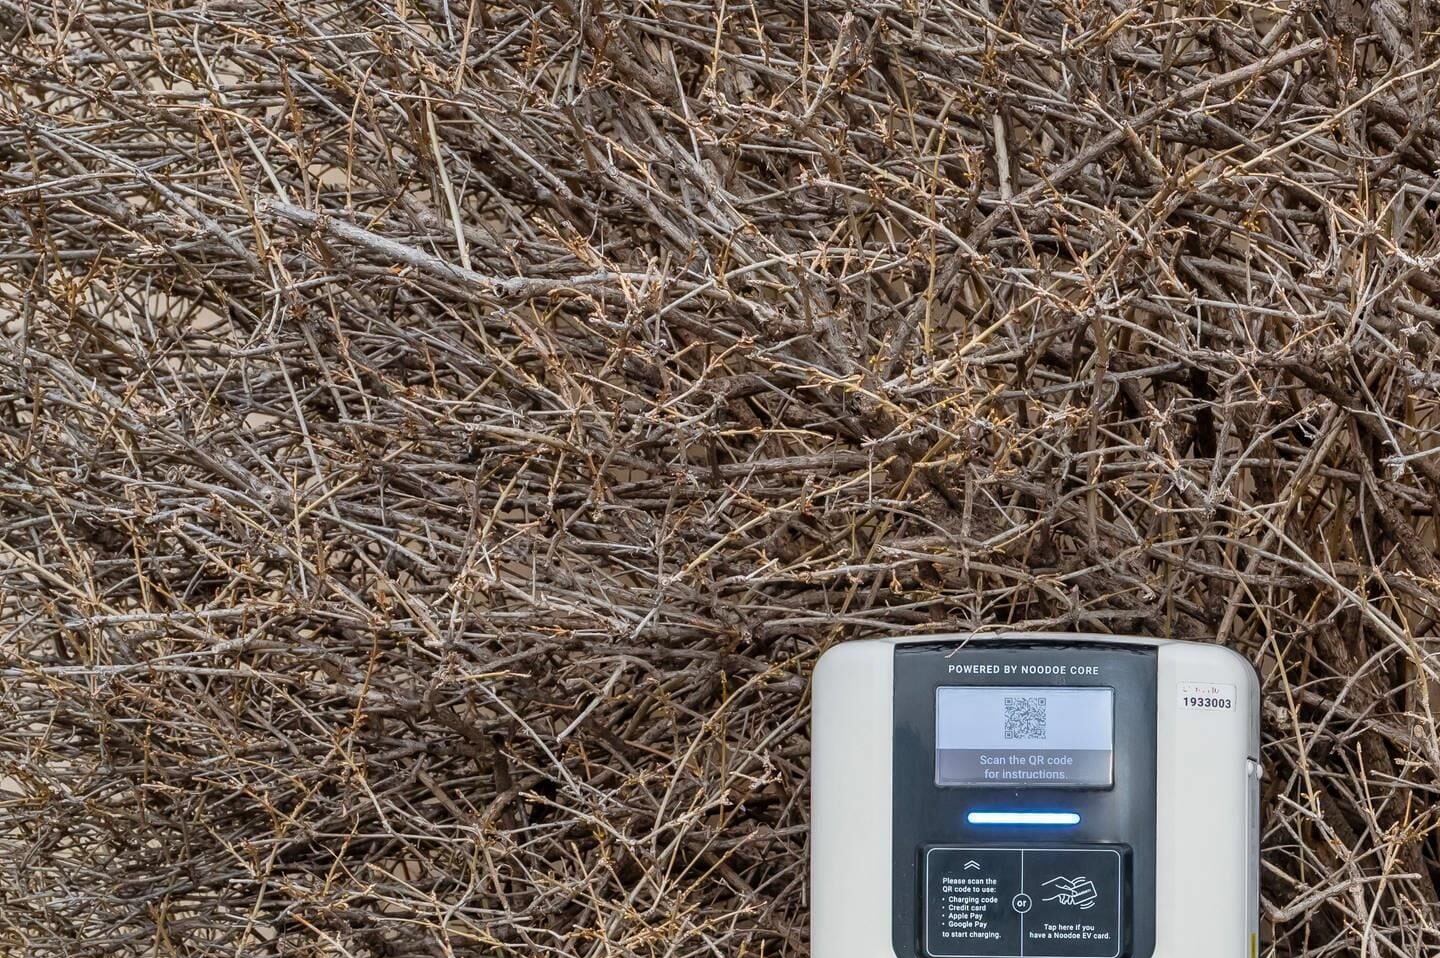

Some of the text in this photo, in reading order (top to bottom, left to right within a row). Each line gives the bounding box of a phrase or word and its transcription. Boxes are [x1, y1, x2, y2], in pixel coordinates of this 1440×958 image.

[948, 665, 1099, 674] POWERED BY NOODOE CORE
[1184, 697, 1231, 708] 1933003
[980, 755, 1073, 765] Scan the QR code
[984, 769, 999, 779] for
